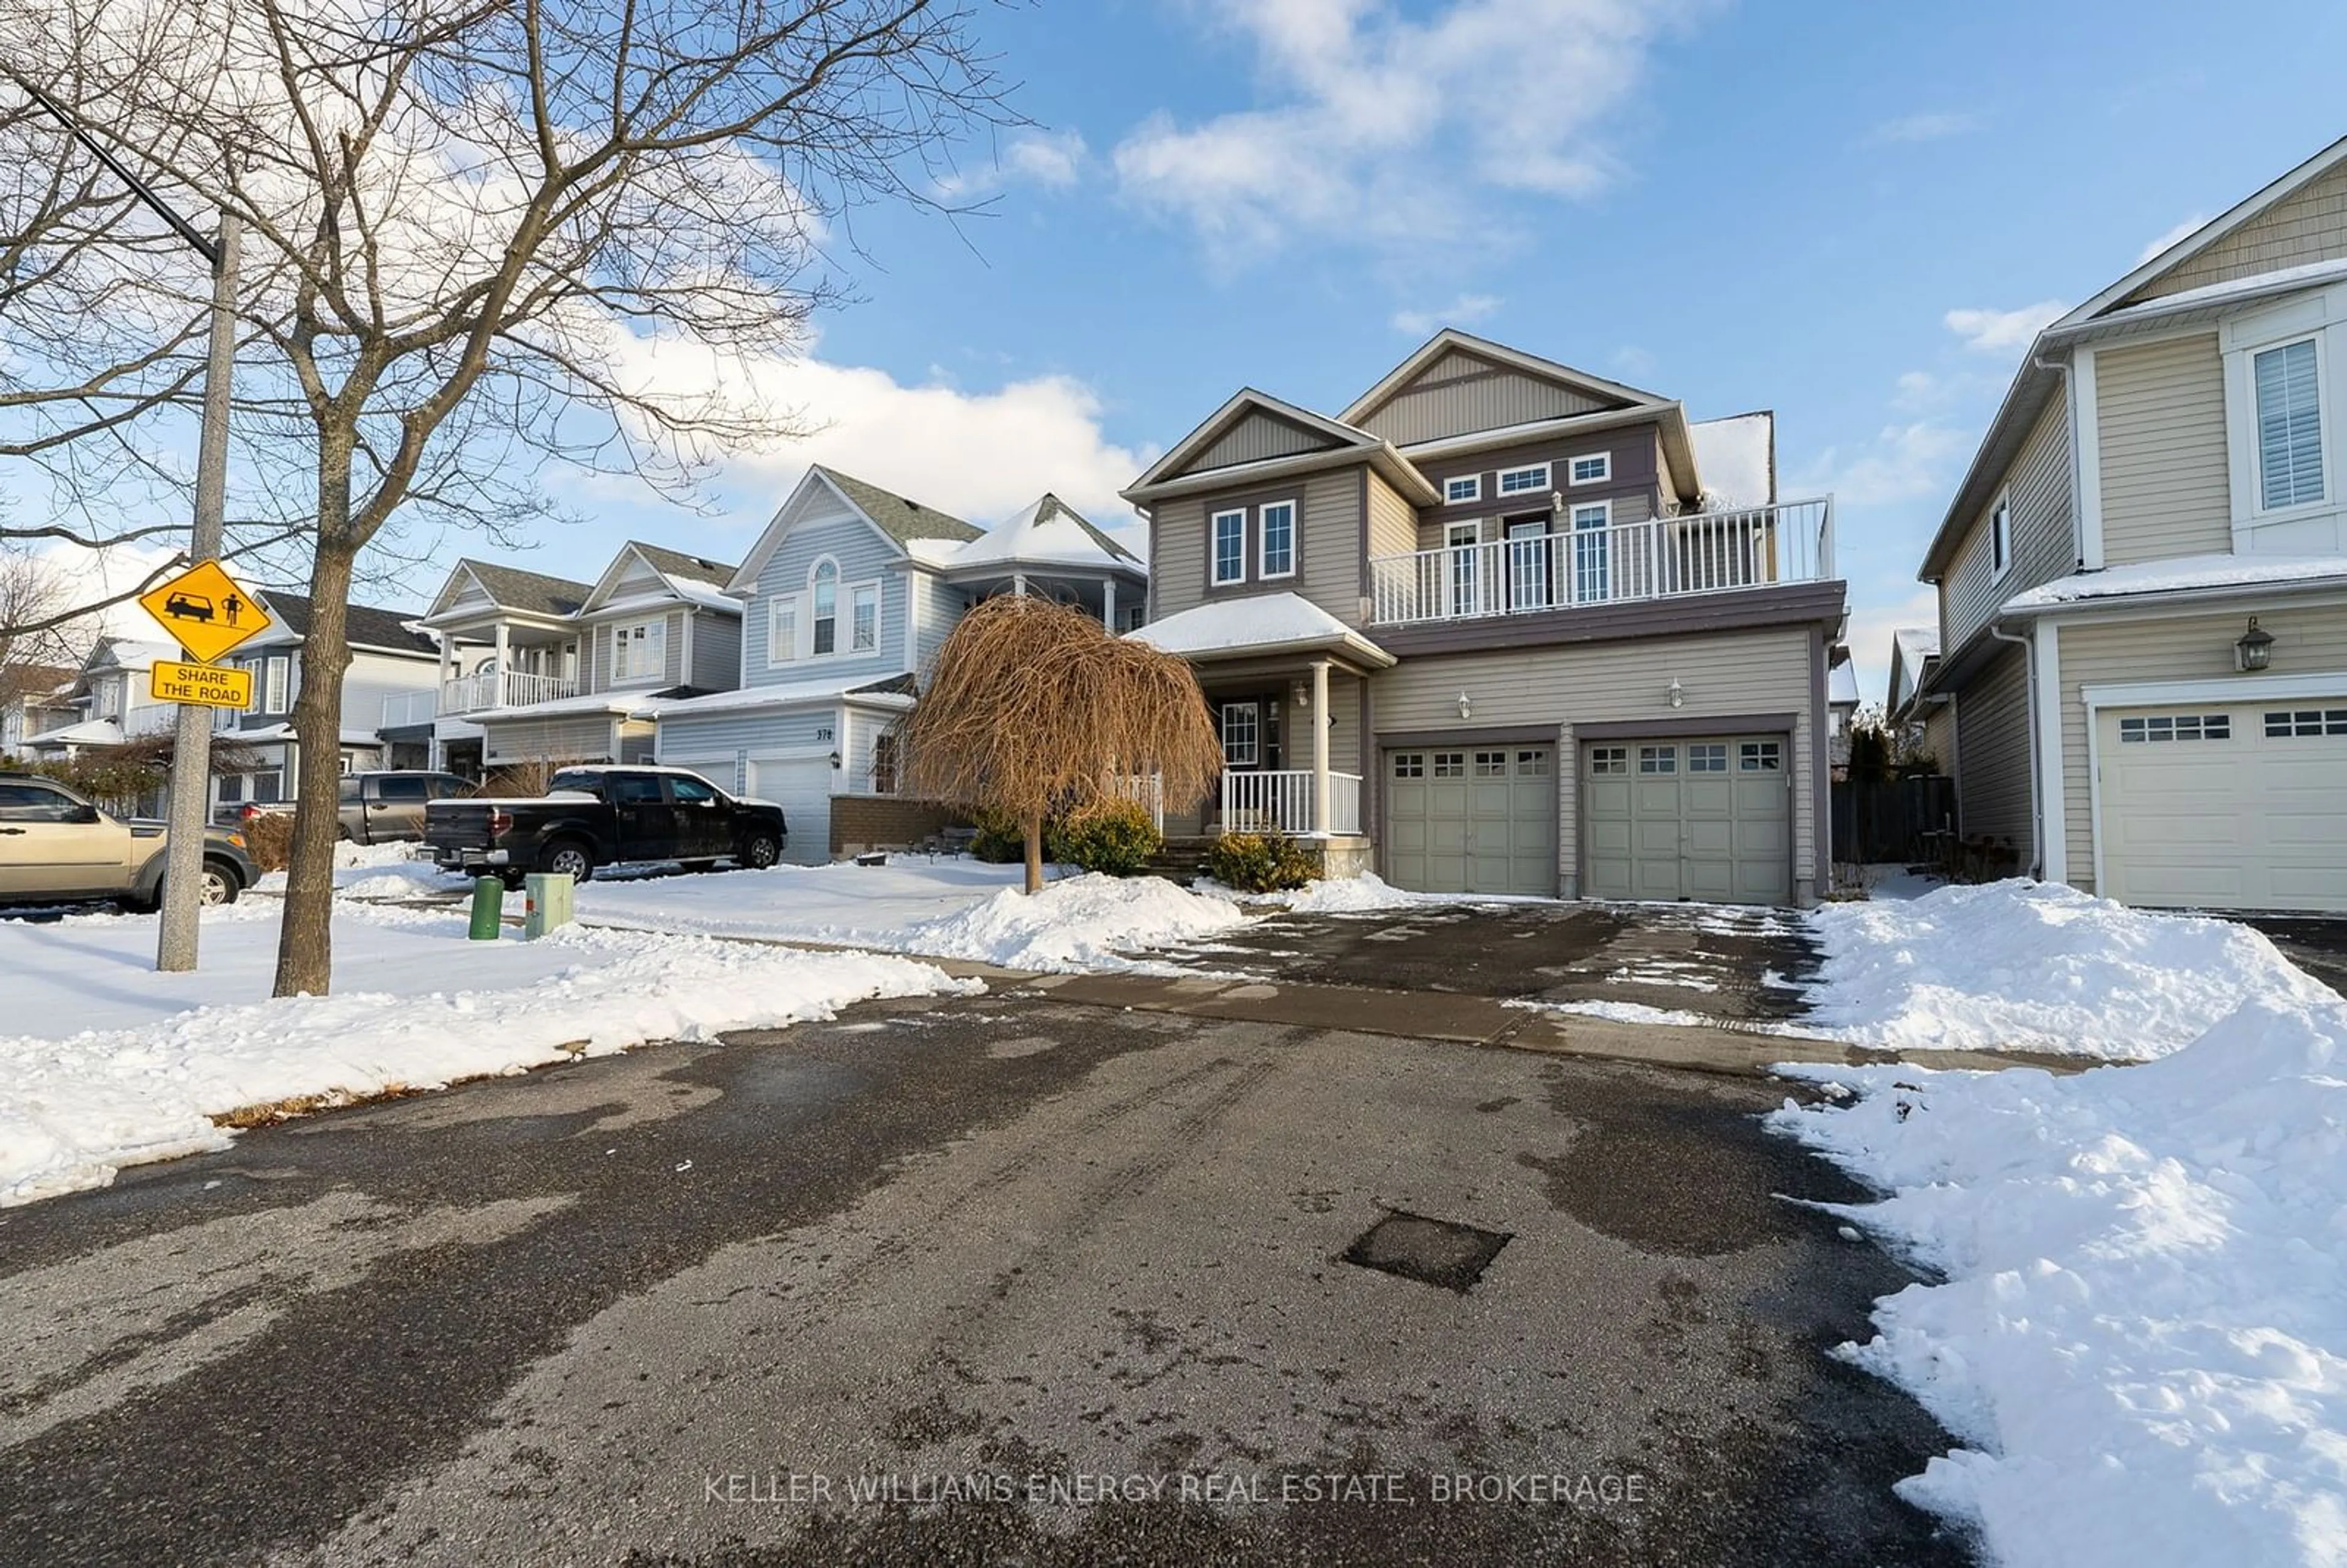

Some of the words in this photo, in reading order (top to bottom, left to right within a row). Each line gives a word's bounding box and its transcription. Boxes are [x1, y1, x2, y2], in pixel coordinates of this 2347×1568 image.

[177, 669, 229, 685] SHARE
[163, 682, 193, 697] THE
[199, 686, 241, 702] ROAD
